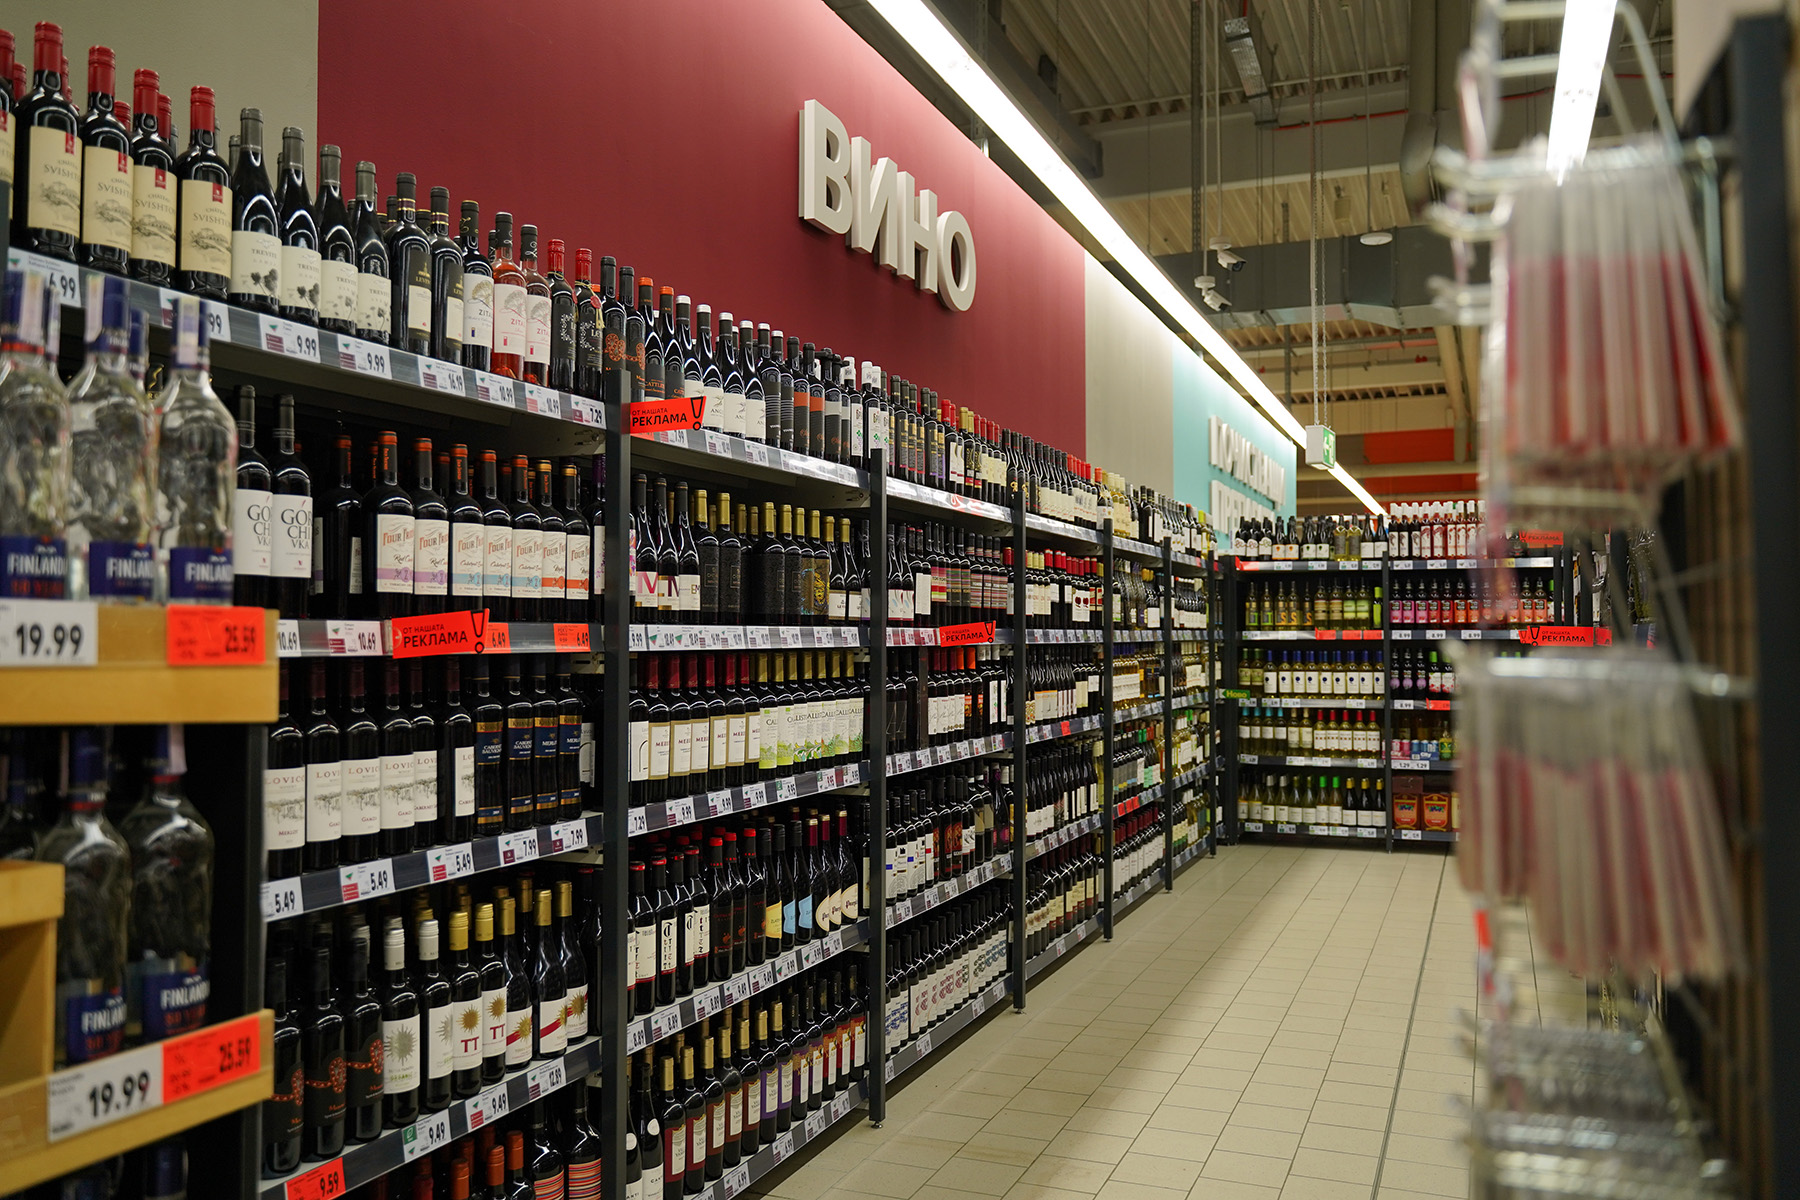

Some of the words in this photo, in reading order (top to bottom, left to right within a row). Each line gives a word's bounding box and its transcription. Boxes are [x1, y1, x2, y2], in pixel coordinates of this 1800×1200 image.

[802, 99, 976, 311] ВИНО
[297, 335, 317, 357] 9.99
[367, 353, 386, 373] 9.99
[590, 408, 603, 423] 7.29
[632, 413, 688, 427] РЕКЛАМА
[414, 624, 445, 632] НАШАТА
[946, 632, 984, 642] РЕКЛАМА
[16, 624, 84, 657] 19.99
[358, 632, 376, 650] 10.69
[403, 630, 468, 648] РЕКЛАМА
[492, 632, 506, 648] 6.49
[577, 632, 590, 648] 6.49
[1542, 635, 1586, 643] РЕКЛАМА
[1226, 690, 1248, 698] Ново
[634, 815, 645, 831] 7.29
[571, 828, 584, 846] 7.99
[522, 838, 537, 857] 7.99
[456, 852, 472, 872] 5.49
[370, 870, 388, 892] 5.49
[275, 890, 296, 914] 5.49
[667, 1014, 678, 1031] 8.89
[490, 1024, 505, 1040] TT
[633, 1029, 644, 1047] 8.89
[461, 1036, 479, 1053] TT
[89, 1071, 150, 1118] 19.99
[492, 1092, 507, 1114] 9.49
[428, 1121, 445, 1145] 9.49
[320, 1171, 338, 1198] 9.59
